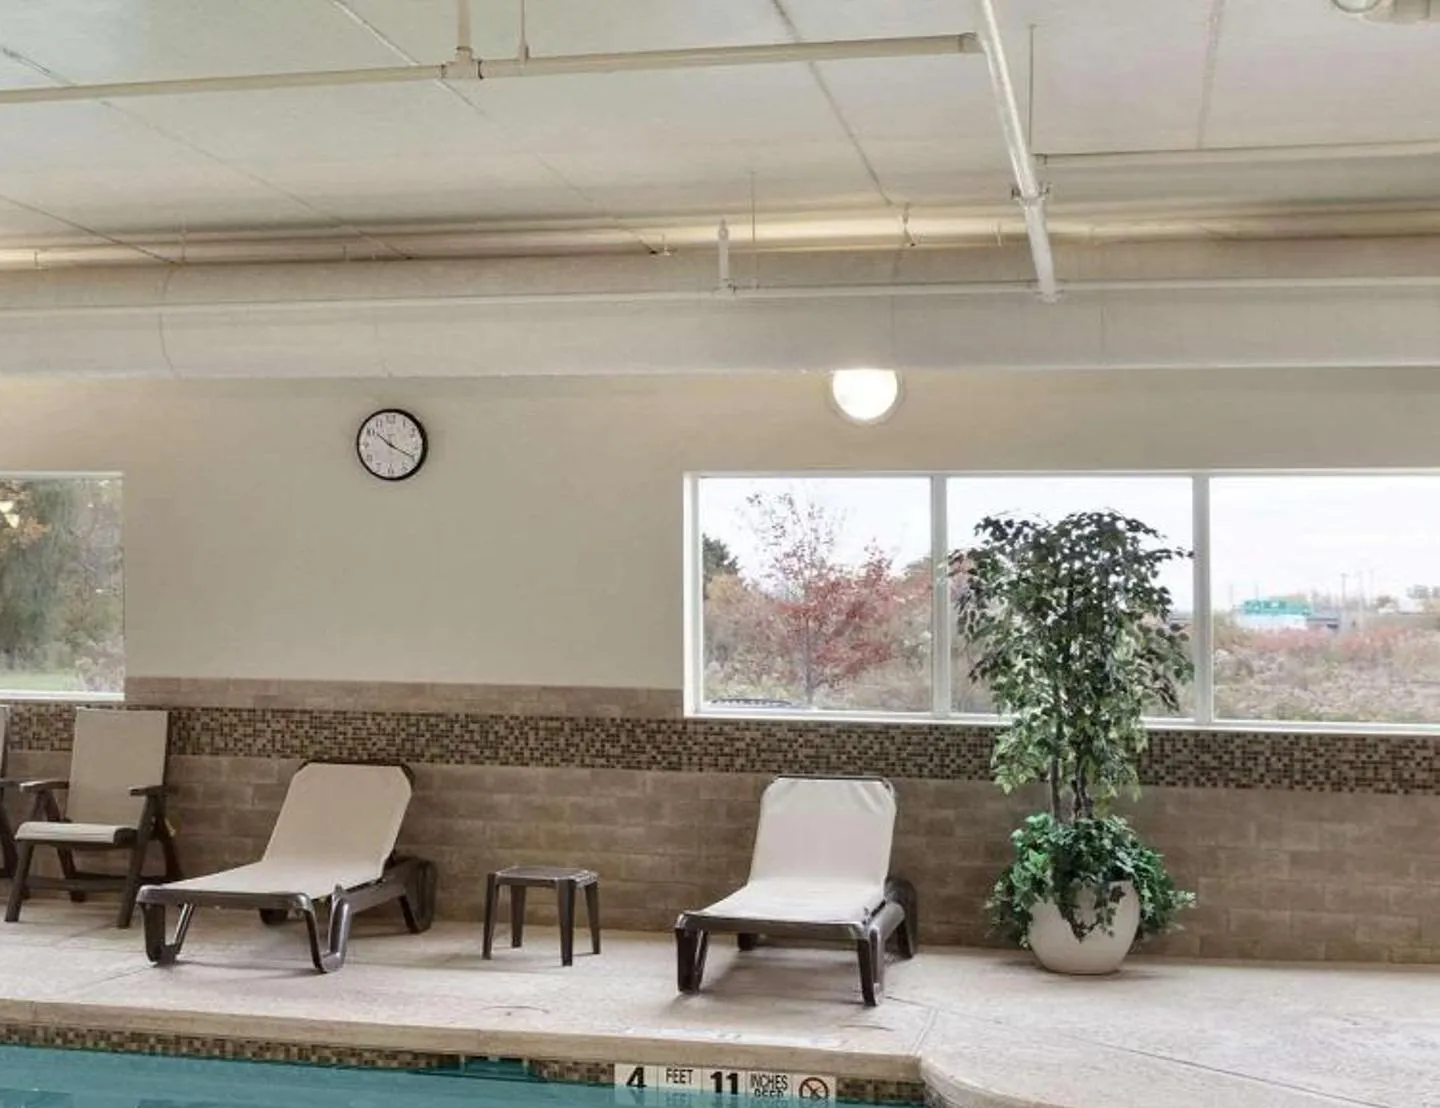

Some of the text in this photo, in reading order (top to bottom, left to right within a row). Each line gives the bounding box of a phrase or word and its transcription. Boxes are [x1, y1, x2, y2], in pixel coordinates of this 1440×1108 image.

[626, 1066, 788, 1096] 4 FEET 11 INCHES
